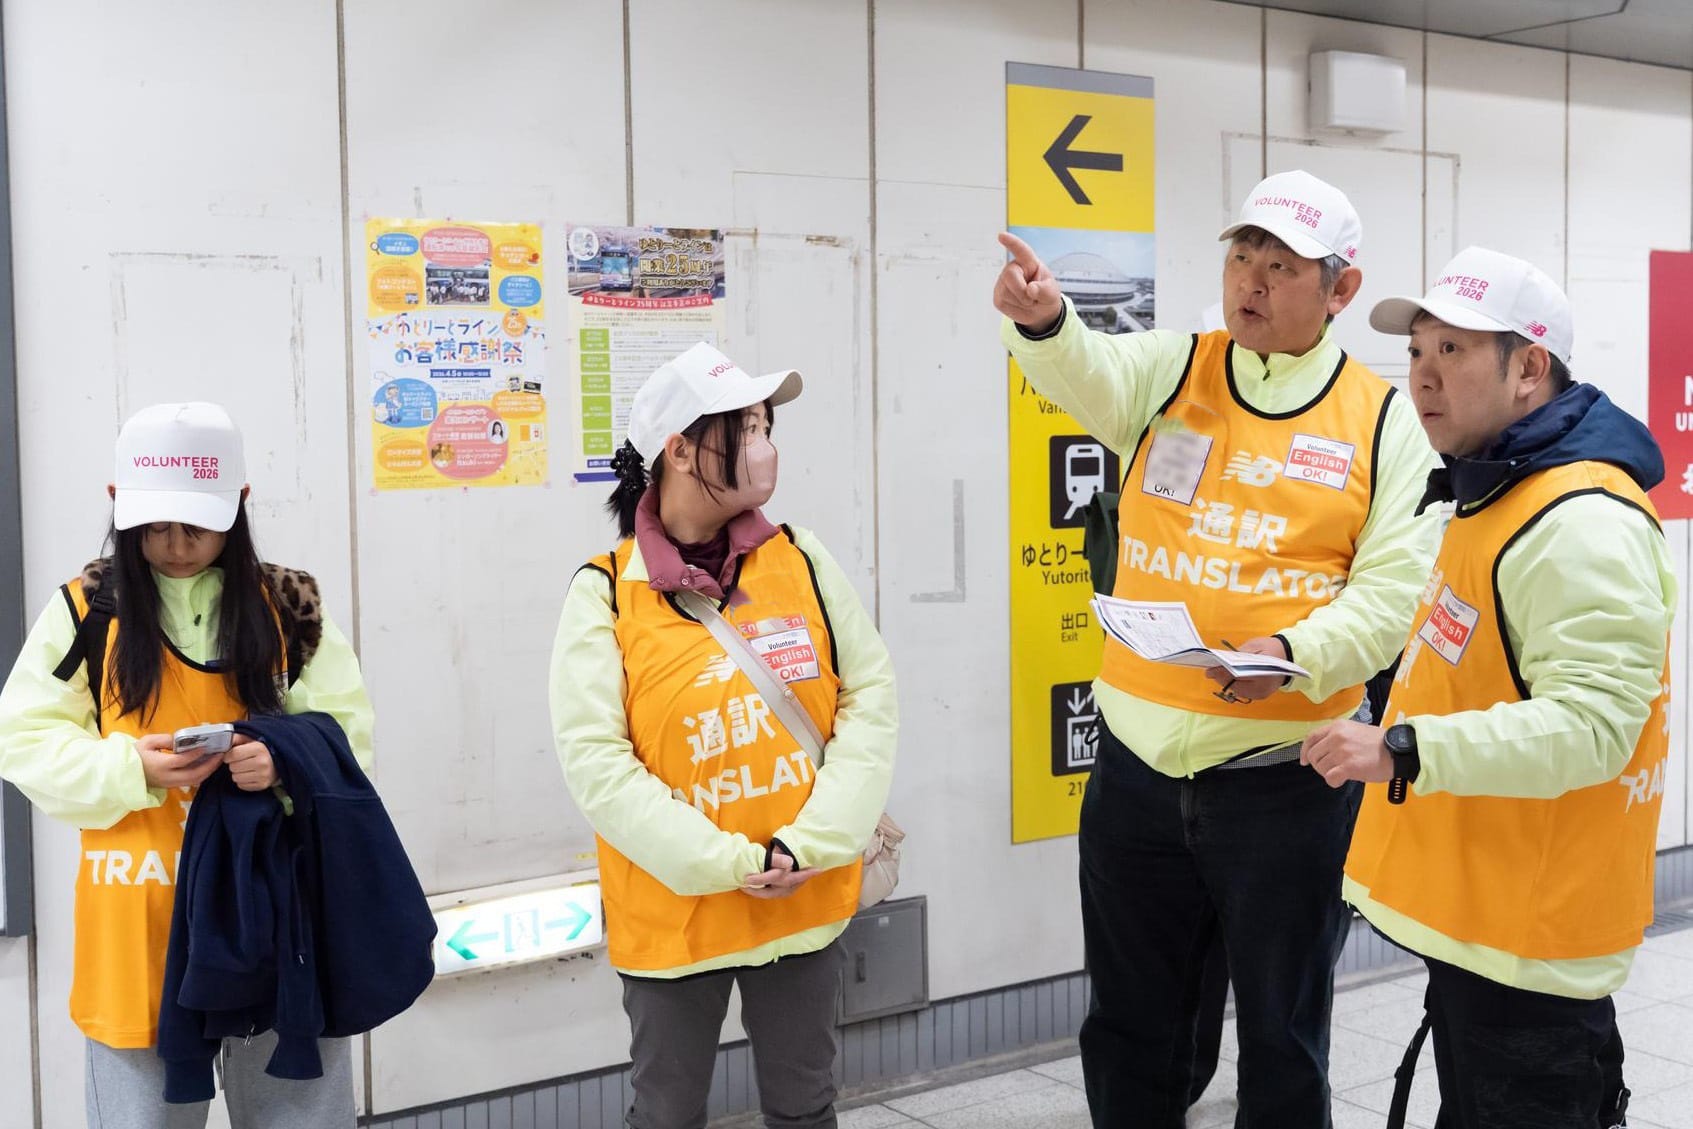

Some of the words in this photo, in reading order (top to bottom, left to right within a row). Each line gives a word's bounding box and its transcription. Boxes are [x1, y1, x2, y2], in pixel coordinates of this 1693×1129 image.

[1255, 197, 1323, 220] VOLUNTEER
[1294, 212, 1319, 229] 2026
[640, 254, 713, 276] 開業25周年
[1456, 286, 1484, 301] 2026
[396, 318, 498, 336] ゆとりーとライン
[395, 338, 523, 363] お客様感謝祭
[1038, 400, 1068, 414] Van
[1307, 443, 1337, 456] Volunteer
[133, 456, 219, 468] VOLUNTEER
[1294, 450, 1344, 471] English
[193, 468, 219, 479] 2026
[1302, 467, 1328, 482] OK!
[1187, 498, 1288, 553] 通訳
[1022, 542, 1083, 567] ゆとりー
[1042, 569, 1089, 585] Yutorit
[1061, 612, 1088, 630] 出口
[768, 639, 798, 650] Volunteer
[1061, 633, 1078, 643] Exit
[780, 665, 805, 680] OK!
[682, 692, 777, 766] 通訳
[673, 750, 817, 812] NSLAT
